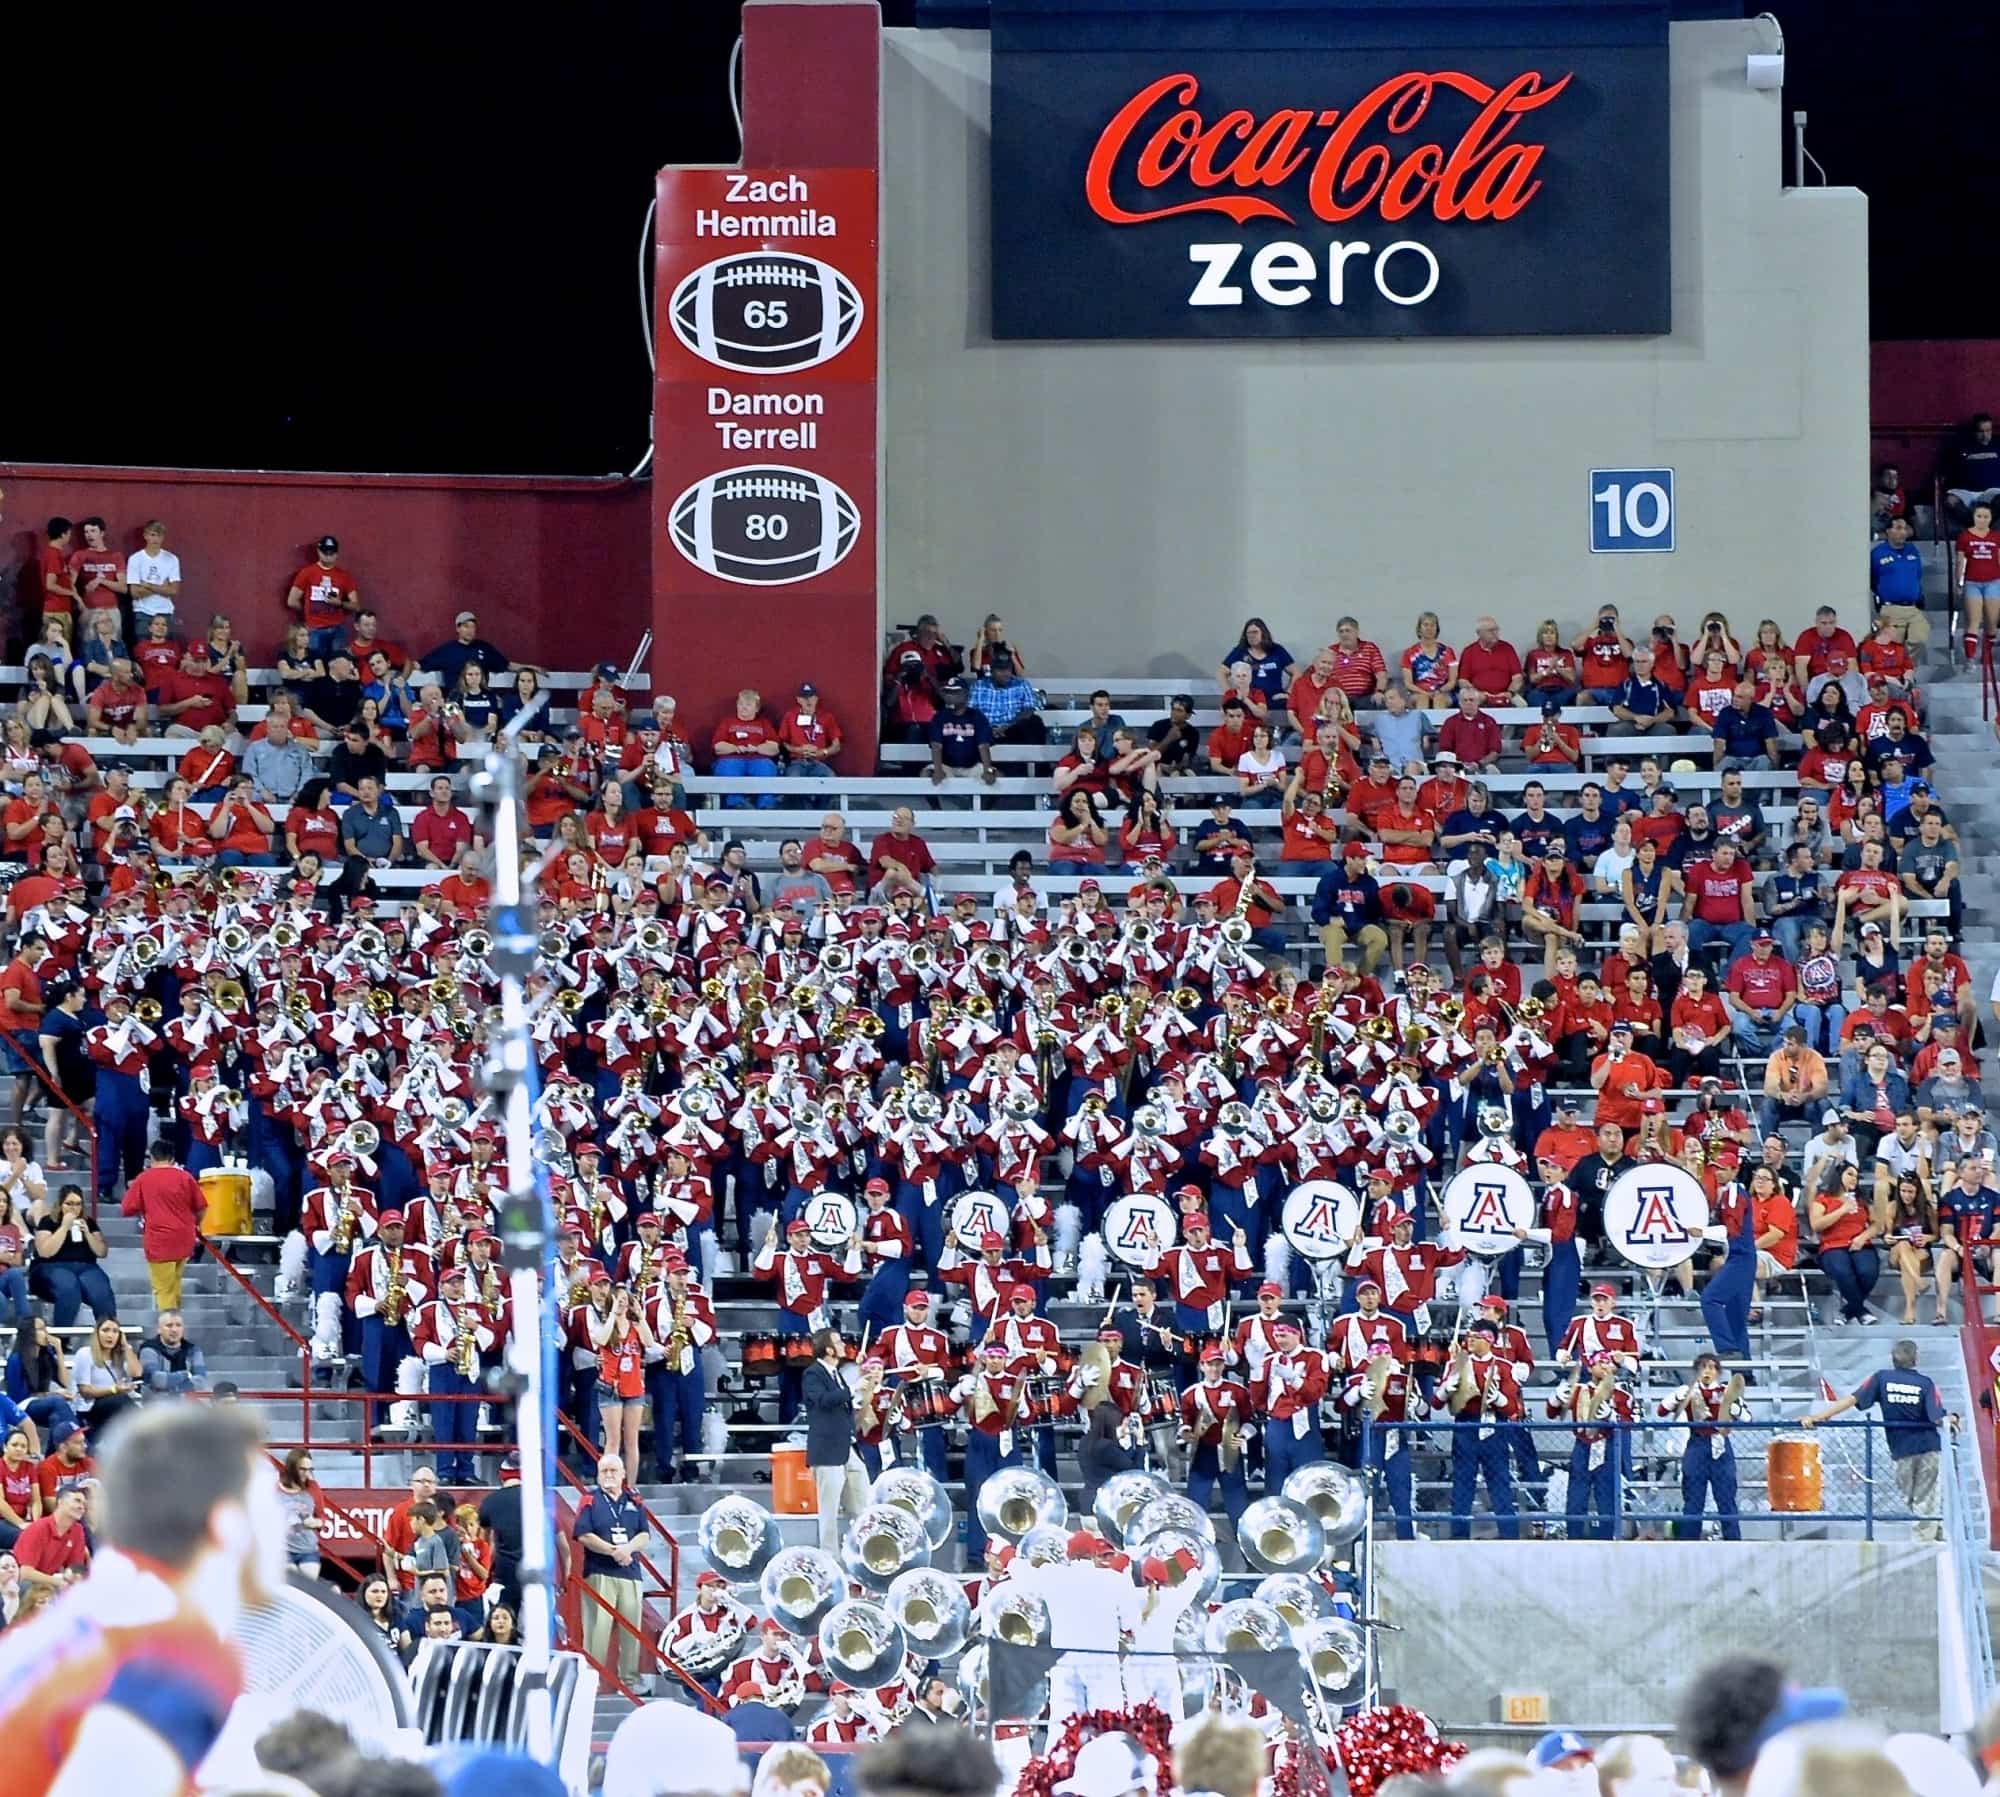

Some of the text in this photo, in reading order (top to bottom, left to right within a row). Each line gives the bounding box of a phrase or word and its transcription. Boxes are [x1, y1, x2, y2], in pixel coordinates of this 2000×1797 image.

[1086, 72, 1573, 225] Coca-Cola
[725, 175, 808, 202] Zach
[696, 210, 836, 237] Hemmila
[1188, 241, 1440, 306] zero
[743, 301, 788, 329] 65
[707, 388, 824, 415] Damon
[715, 423, 816, 450] Terrell
[745, 514, 788, 541] 80
[1594, 483, 1670, 538] 10
[815, 1203, 848, 1234] A
[961, 1202, 993, 1236] A
[1294, 1194, 1346, 1243] A
[1460, 1183, 1517, 1234] A
[1626, 1187, 1689, 1244] A
[1117, 1208, 1161, 1248] A
